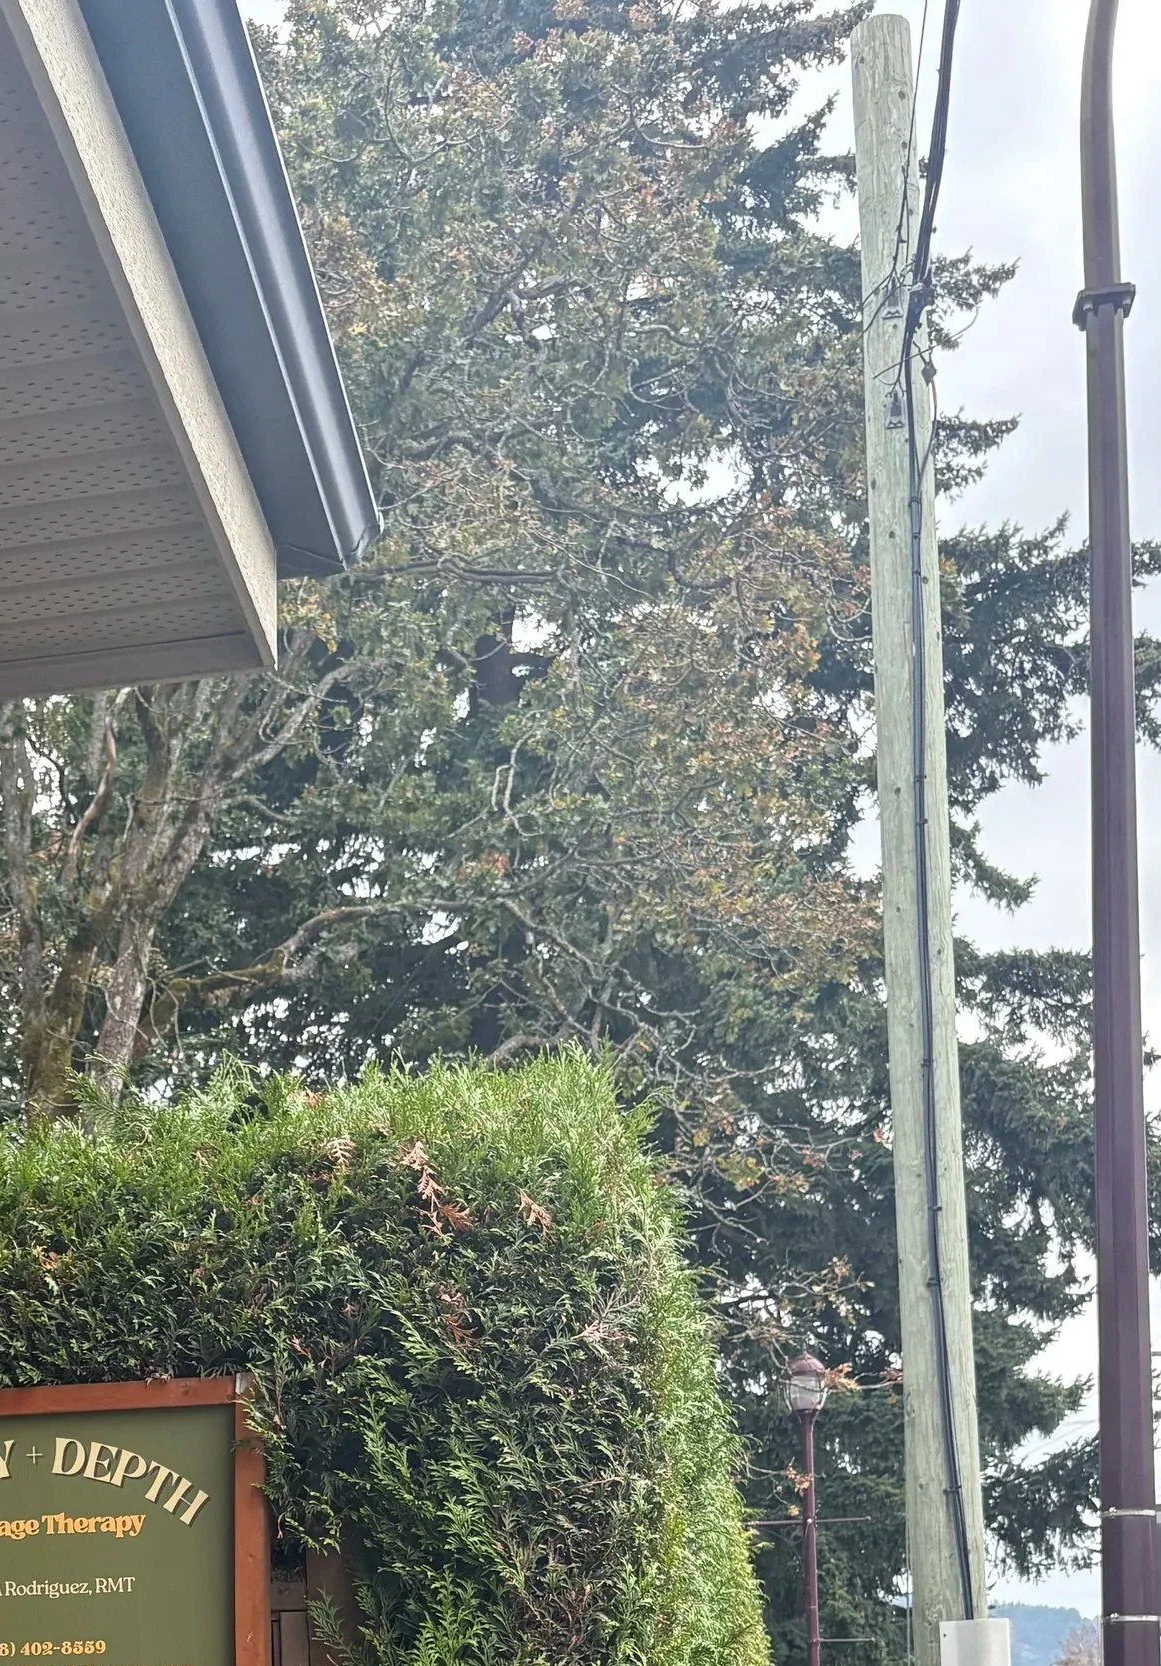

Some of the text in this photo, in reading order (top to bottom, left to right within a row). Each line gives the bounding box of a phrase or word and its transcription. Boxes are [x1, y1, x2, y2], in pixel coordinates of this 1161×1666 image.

[51, 1437, 210, 1528] DEPTH
[42, 1512, 146, 1537] Therapy
[5, 1579, 92, 1597] Rodriguez,
[95, 1577, 135, 1592] RMT
[20, 1640, 106, 1656] 402-8559
